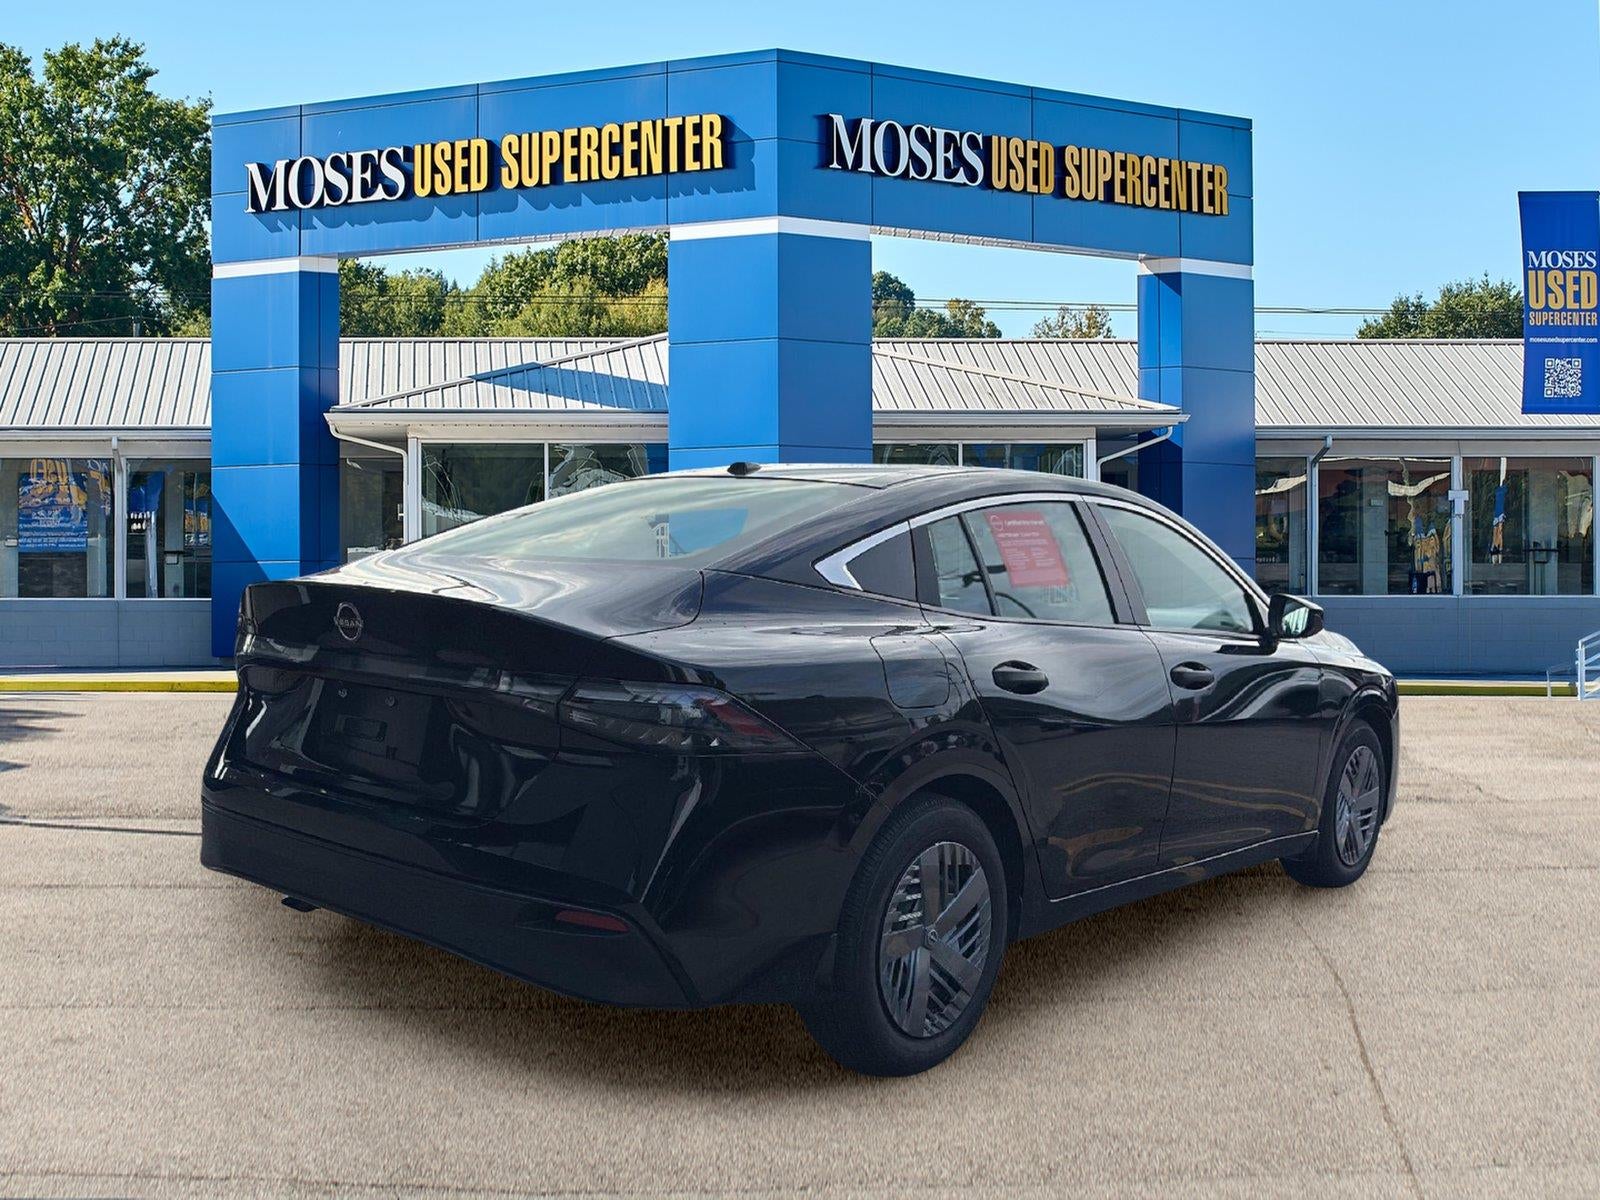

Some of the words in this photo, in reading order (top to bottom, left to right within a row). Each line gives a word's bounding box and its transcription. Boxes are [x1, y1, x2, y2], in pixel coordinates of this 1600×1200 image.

[244, 147, 406, 213] MOSES
[413, 139, 489, 198] USED
[501, 113, 723, 189] SUPERCENTER
[829, 113, 984, 186] MOSES
[991, 135, 1054, 194] USED
[1065, 145, 1229, 215] SUPERCENTER
[1527, 250, 1596, 268] MOSES
[1528, 270, 1597, 310] USED
[1529, 311, 1598, 326] SUPERCENTER
